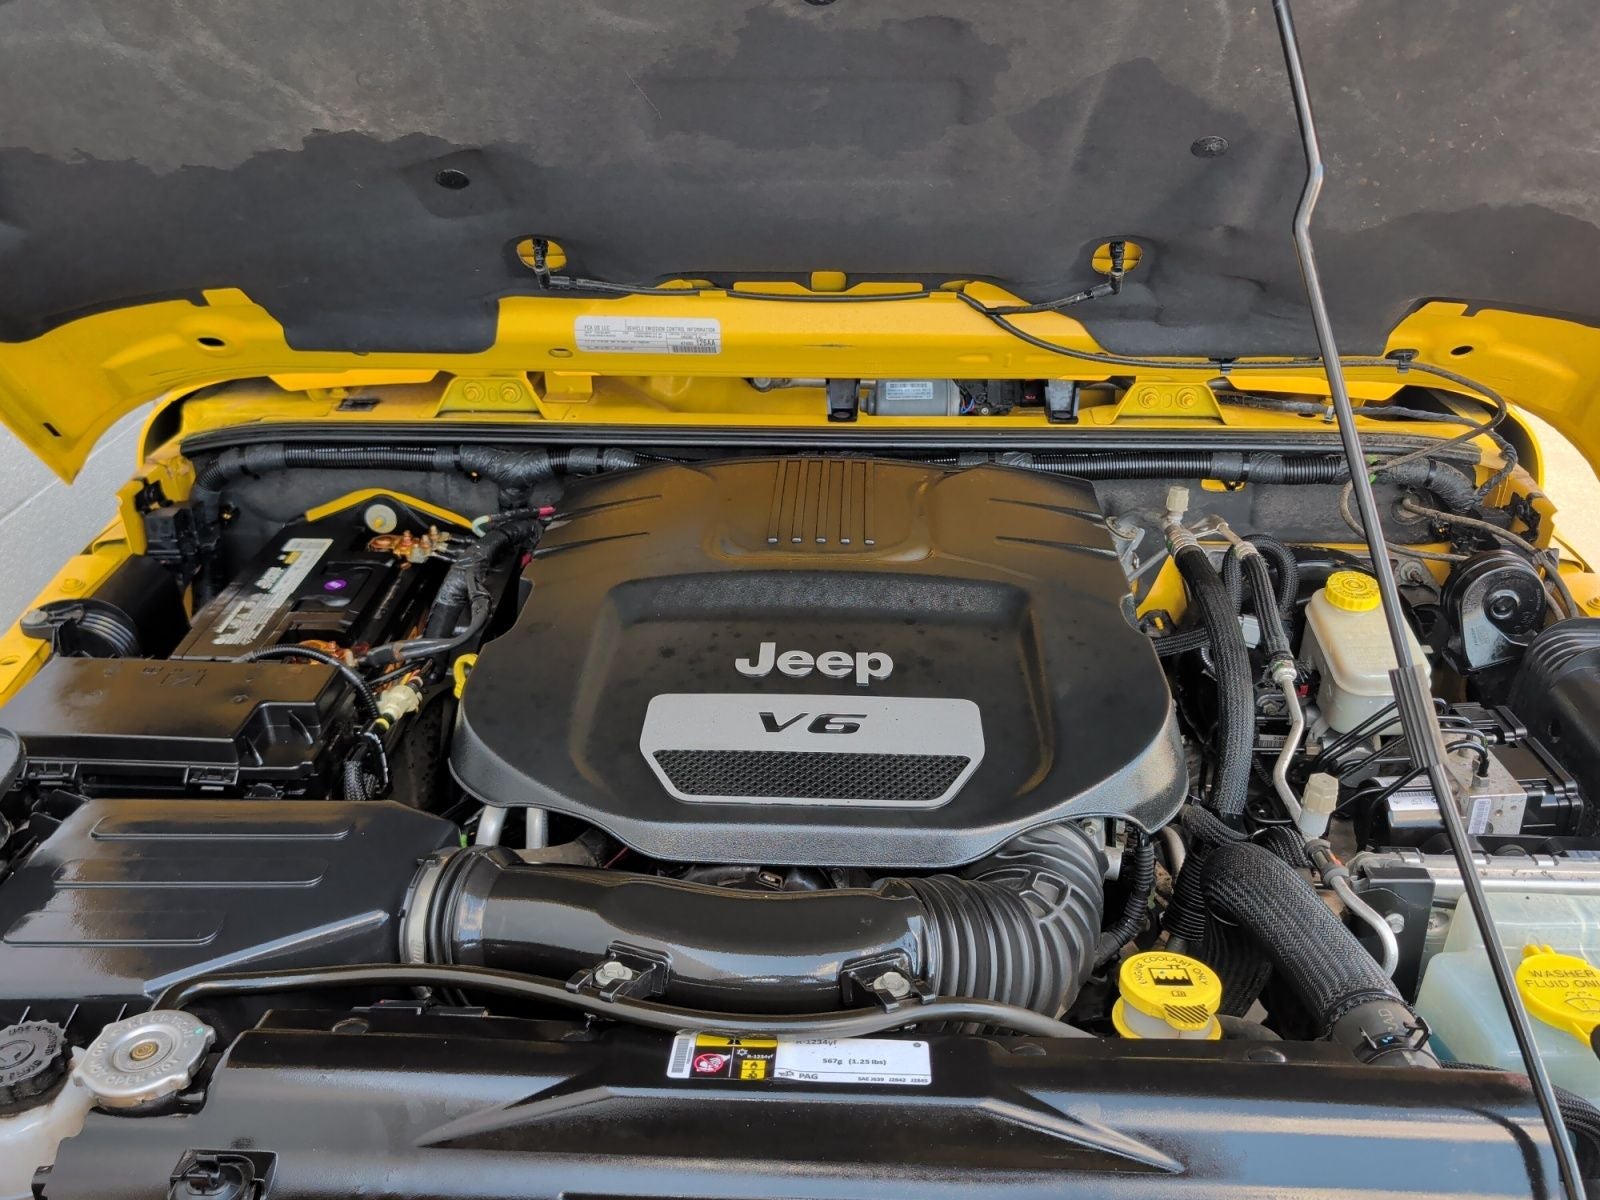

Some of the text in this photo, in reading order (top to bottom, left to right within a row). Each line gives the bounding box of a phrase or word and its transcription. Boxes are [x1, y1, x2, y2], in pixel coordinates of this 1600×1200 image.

[734, 641, 894, 687] Jeep
[758, 711, 867, 734] V6
[1143, 956, 1192, 967] COOLANT
[1192, 968, 1209, 986] ONLY
[1528, 969, 1596, 978] WASHER
[1524, 979, 1570, 988] FLUID
[871, 1058, 887, 1066] lbs)
[798, 1072, 818, 1080] PAG
